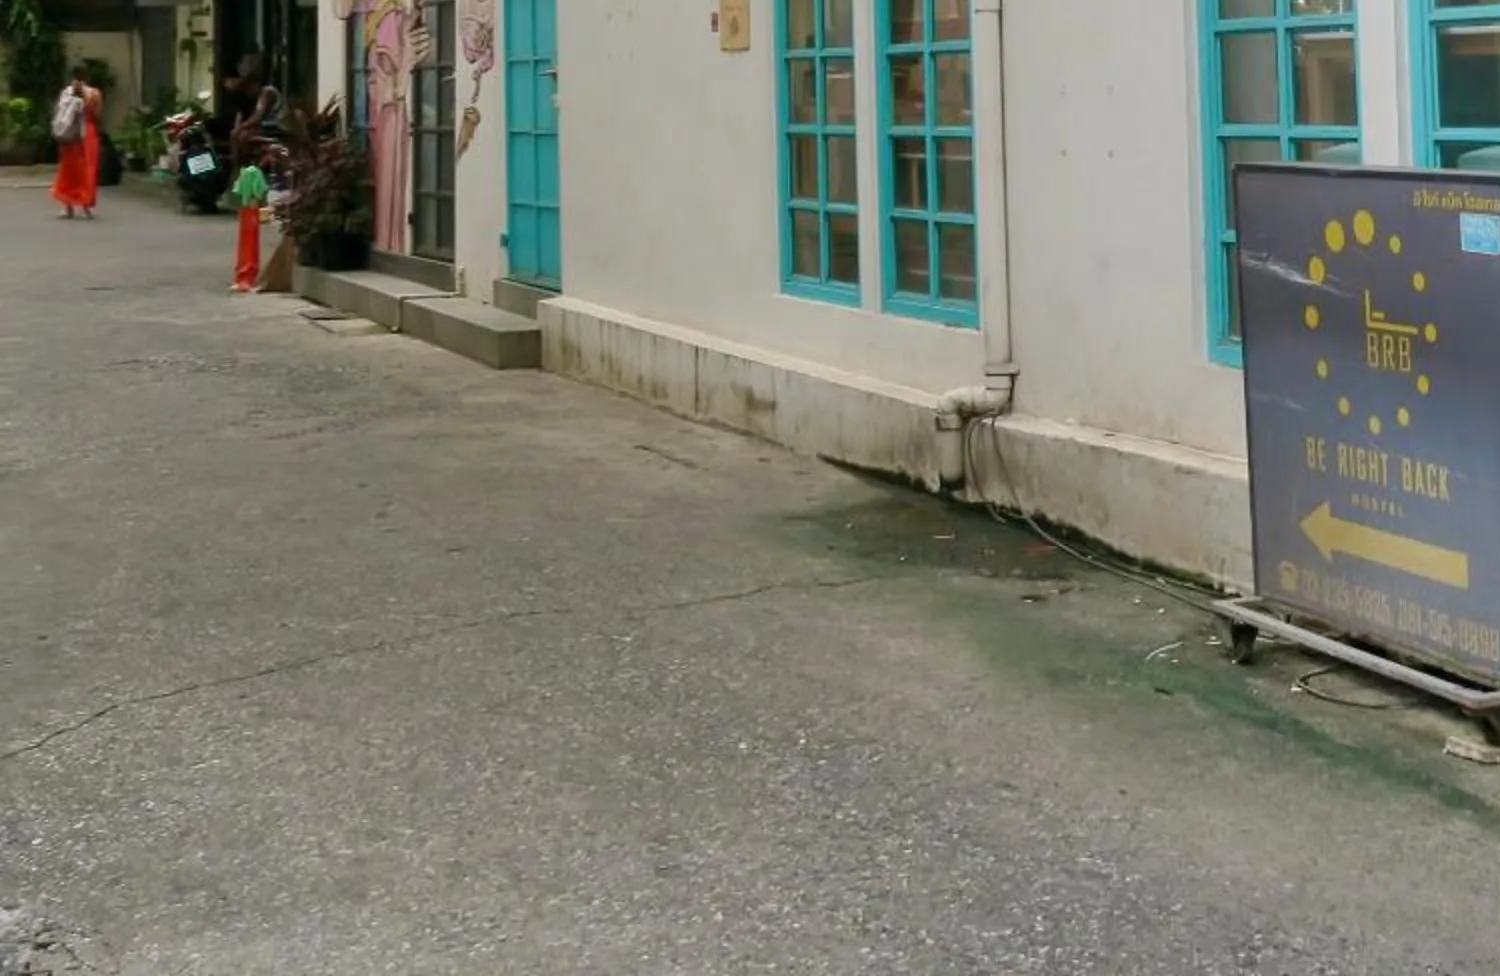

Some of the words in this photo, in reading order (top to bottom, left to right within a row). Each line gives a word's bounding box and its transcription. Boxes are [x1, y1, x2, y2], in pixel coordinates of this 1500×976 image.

[1365, 332, 1412, 373] BRB
[1305, 435, 1326, 473] BE
[1337, 442, 1389, 486] RIGHT
[1401, 457, 1451, 502] BACK
